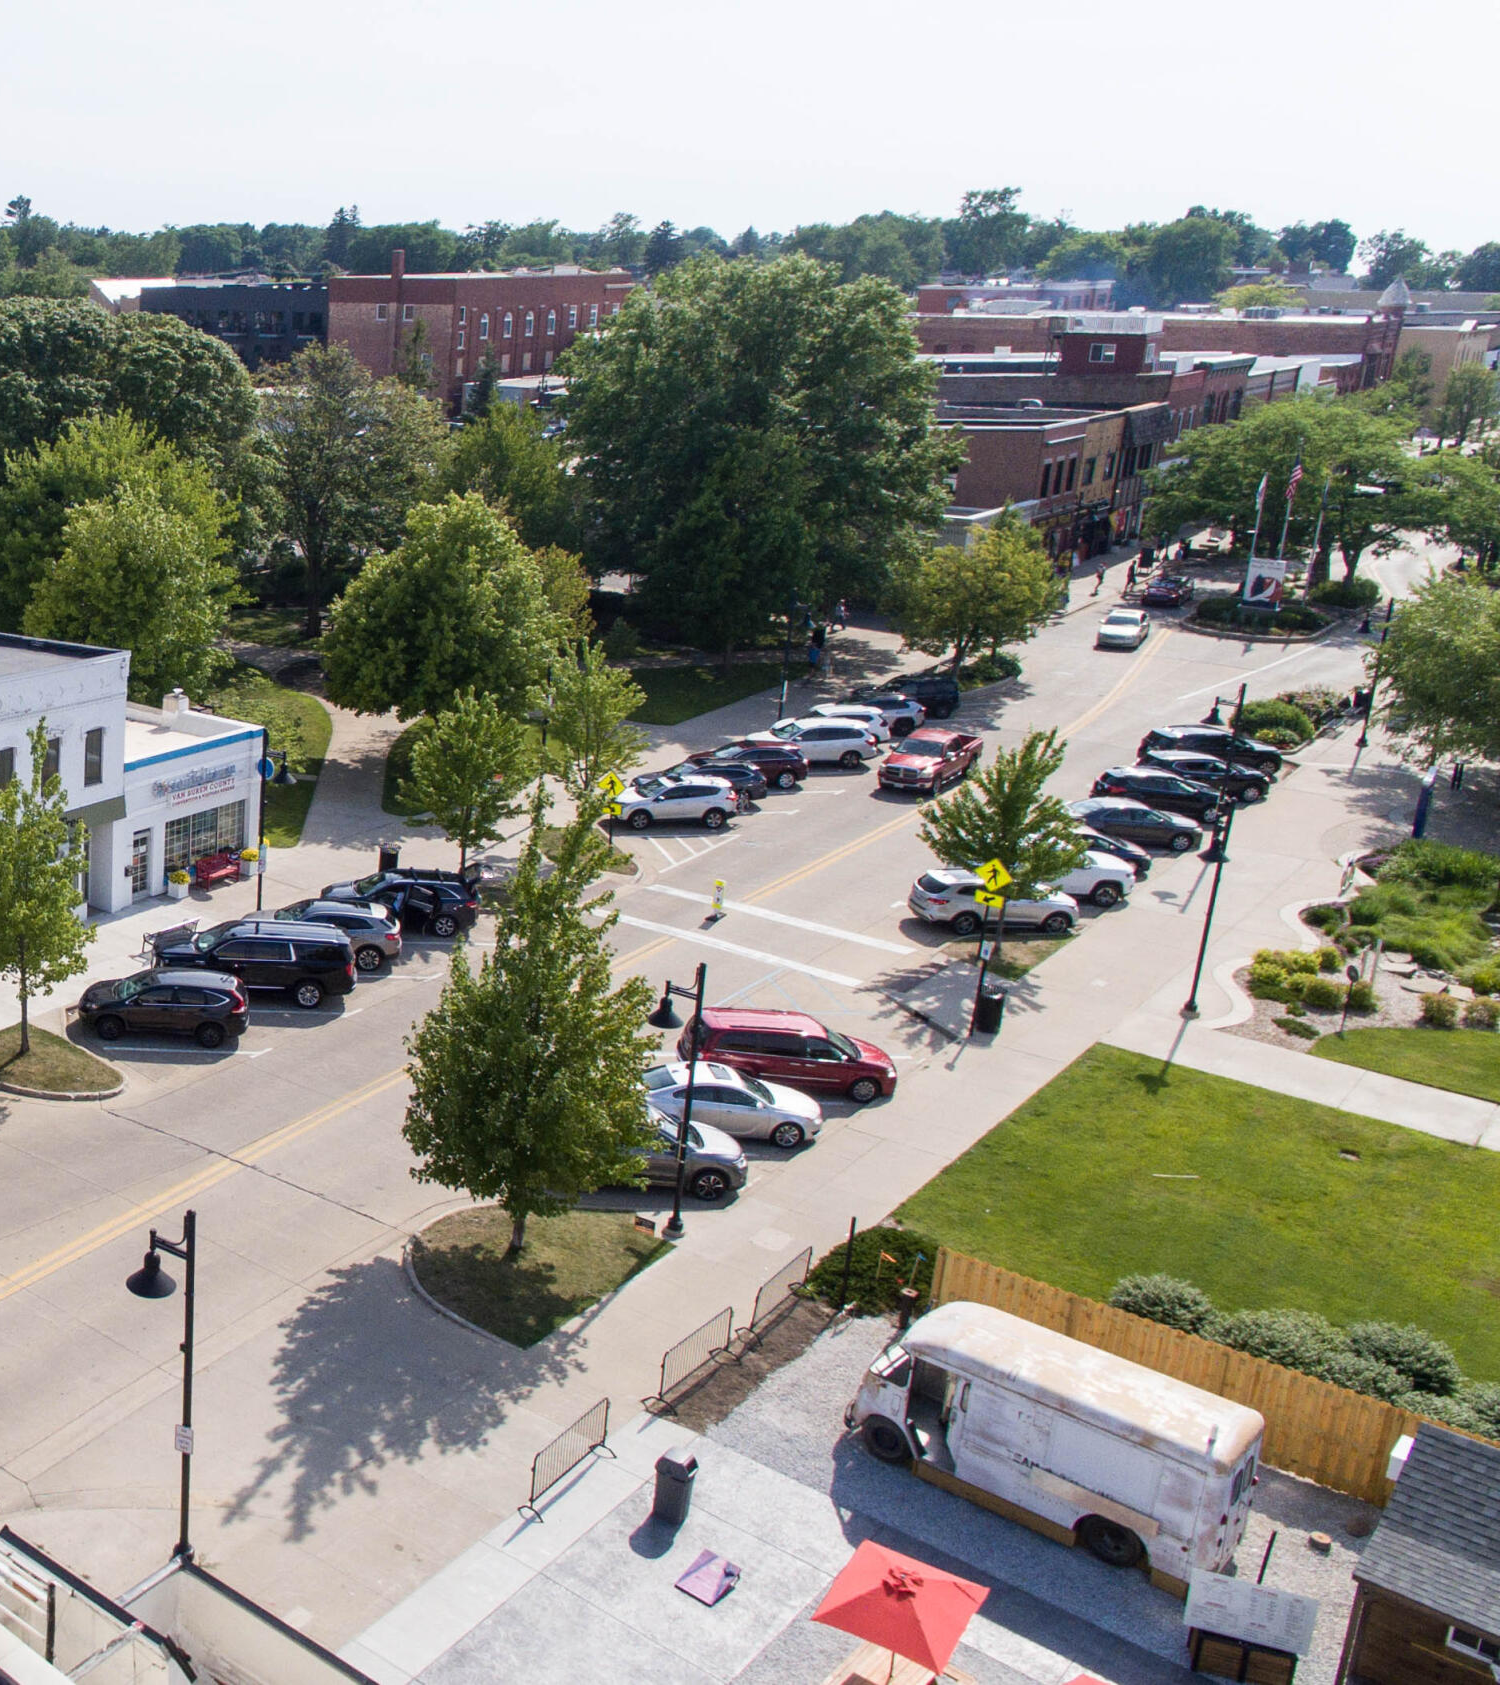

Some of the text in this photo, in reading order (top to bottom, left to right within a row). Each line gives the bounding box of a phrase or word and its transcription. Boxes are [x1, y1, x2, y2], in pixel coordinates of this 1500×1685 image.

[172, 778, 235, 801] VAN BUREN COUNTY
